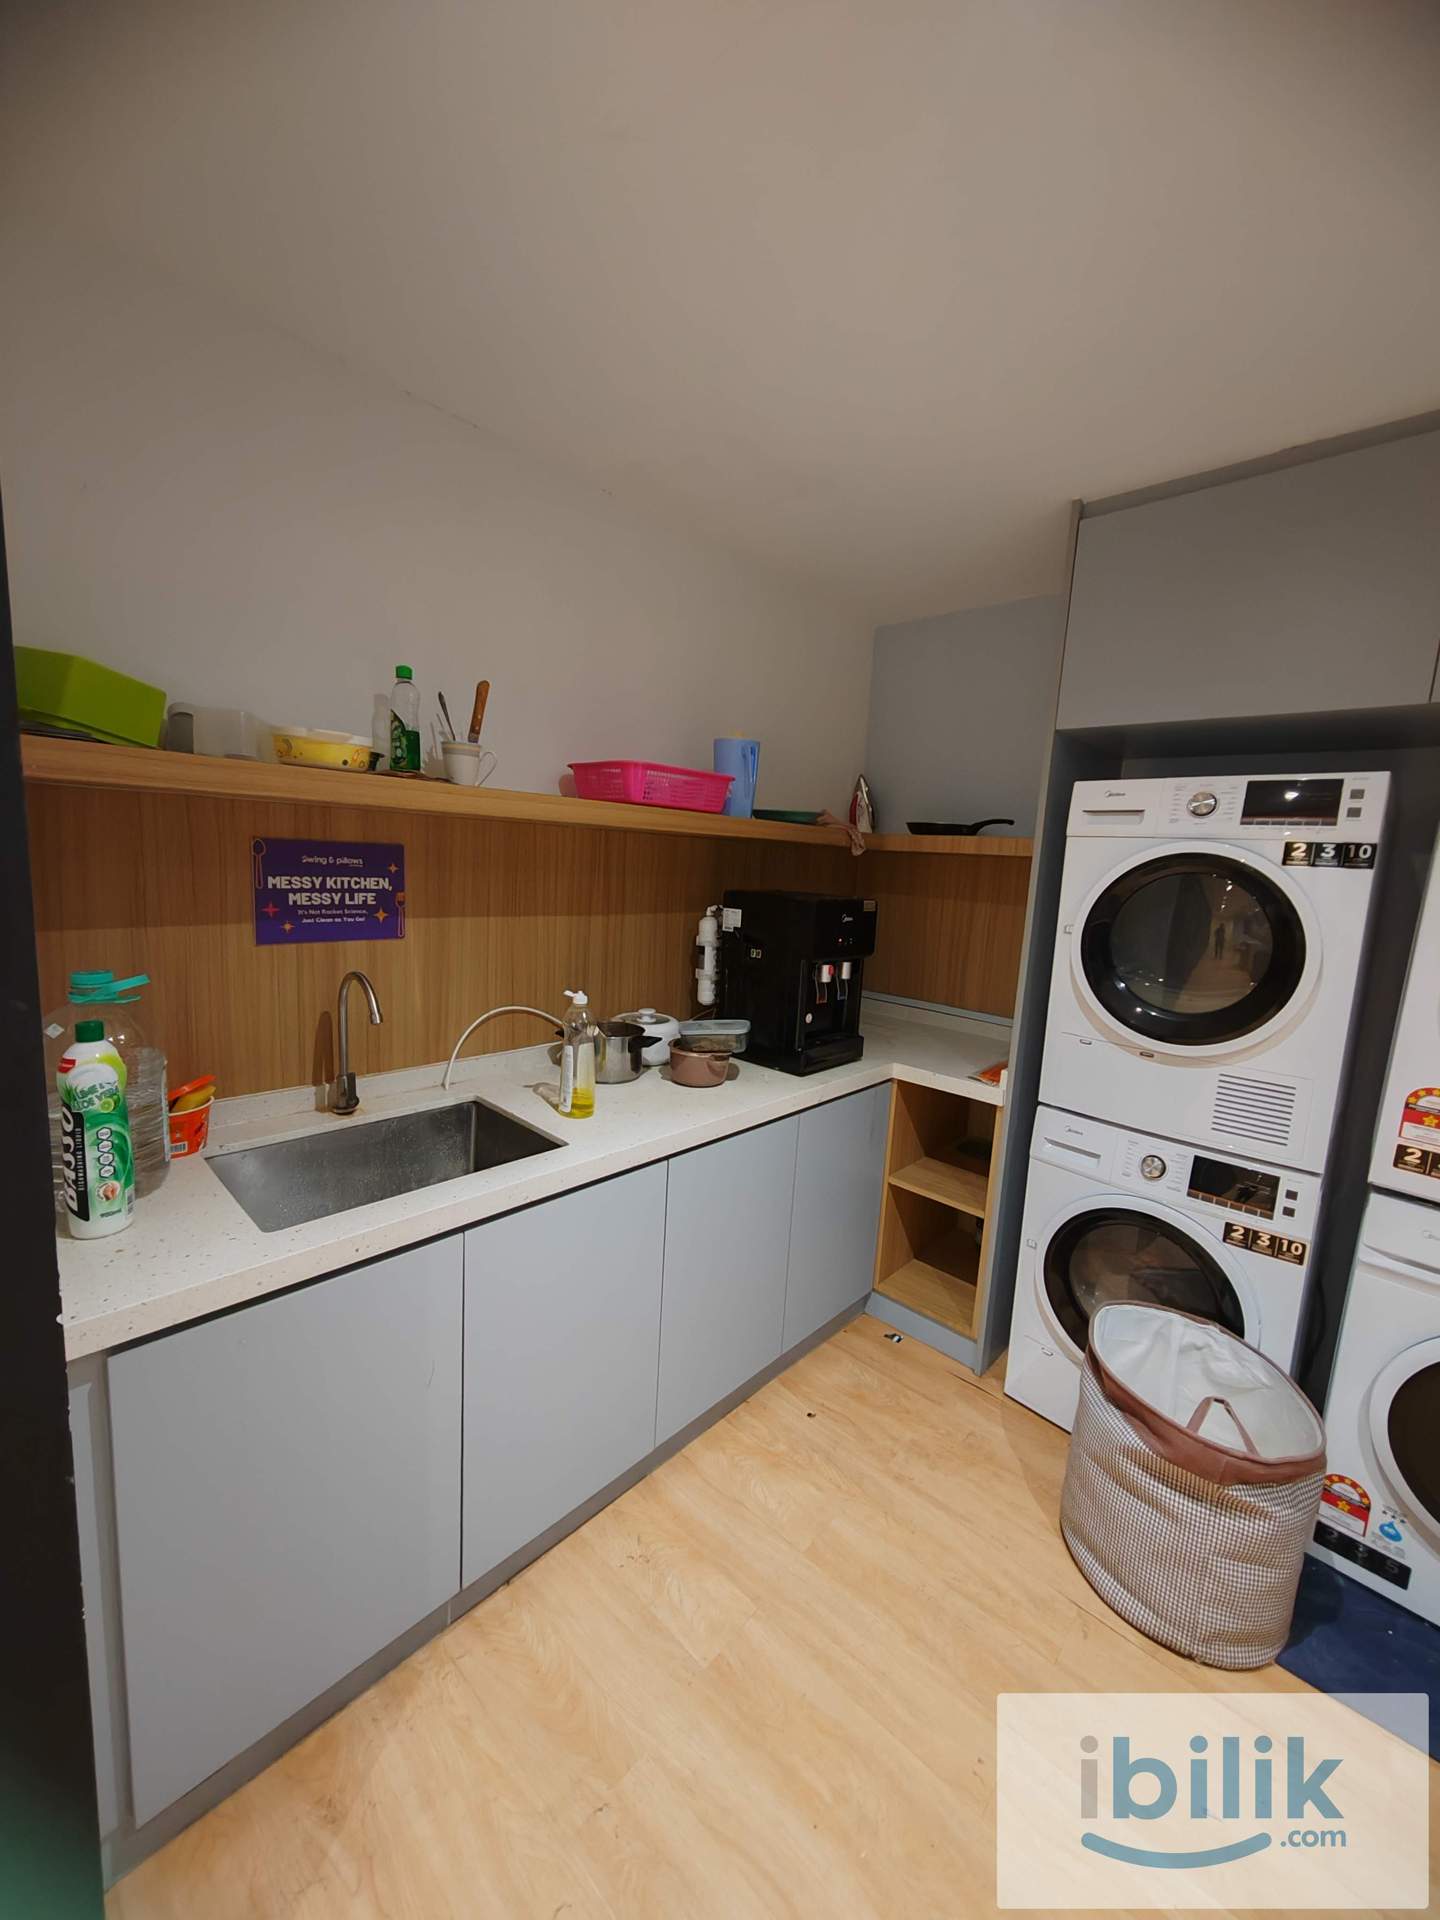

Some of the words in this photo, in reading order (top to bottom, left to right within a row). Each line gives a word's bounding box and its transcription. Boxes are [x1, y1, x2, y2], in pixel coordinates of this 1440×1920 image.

[1290, 842, 1307, 857] 2
[1320, 843, 1336, 857] 3
[1348, 844, 1372, 859] 10
[267, 876, 323, 889] MESSY
[326, 876, 393, 891] KITCHEN,
[288, 892, 342, 905] MESSY
[344, 892, 377, 905] LIFE
[1404, 1147, 1422, 1163] 2
[1230, 1225, 1245, 1239] 2
[1256, 1232, 1271, 1246] 3
[1281, 1239, 1303, 1255] 10
